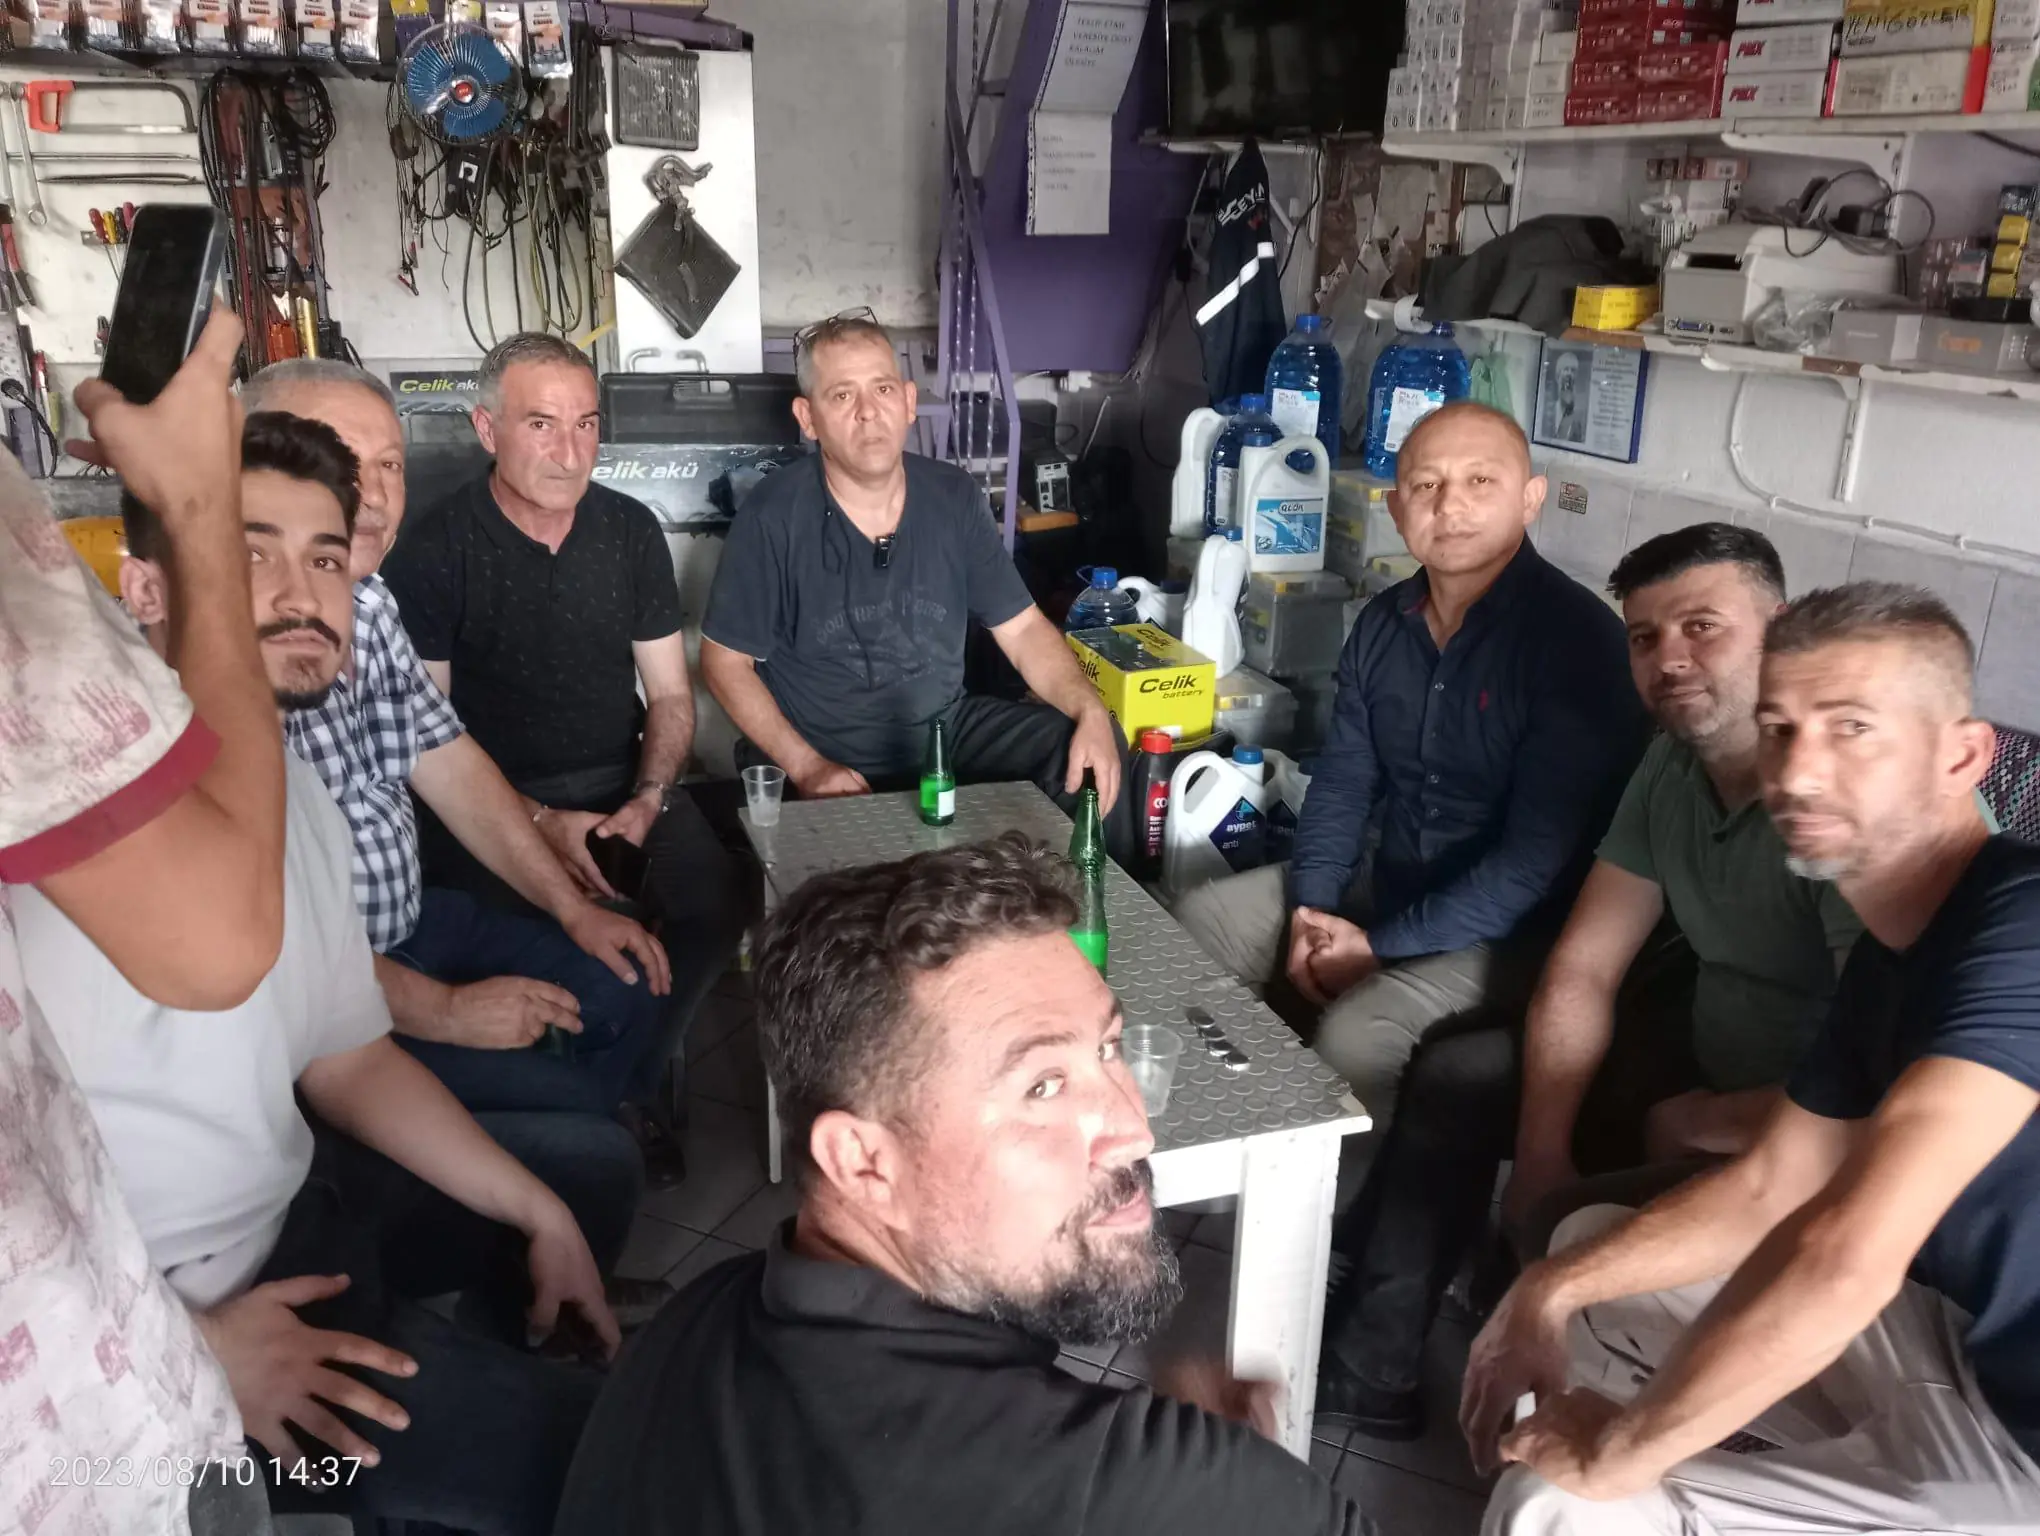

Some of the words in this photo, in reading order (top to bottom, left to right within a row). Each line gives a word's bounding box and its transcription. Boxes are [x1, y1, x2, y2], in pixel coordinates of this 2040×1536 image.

[400, 378, 456, 394] Çelik
[590, 461, 648, 479] elik
[650, 462, 700, 479] akü
[1139, 674, 1199, 694] Celik
[1162, 688, 1205, 700] battery
[1226, 818, 1258, 833] aypet
